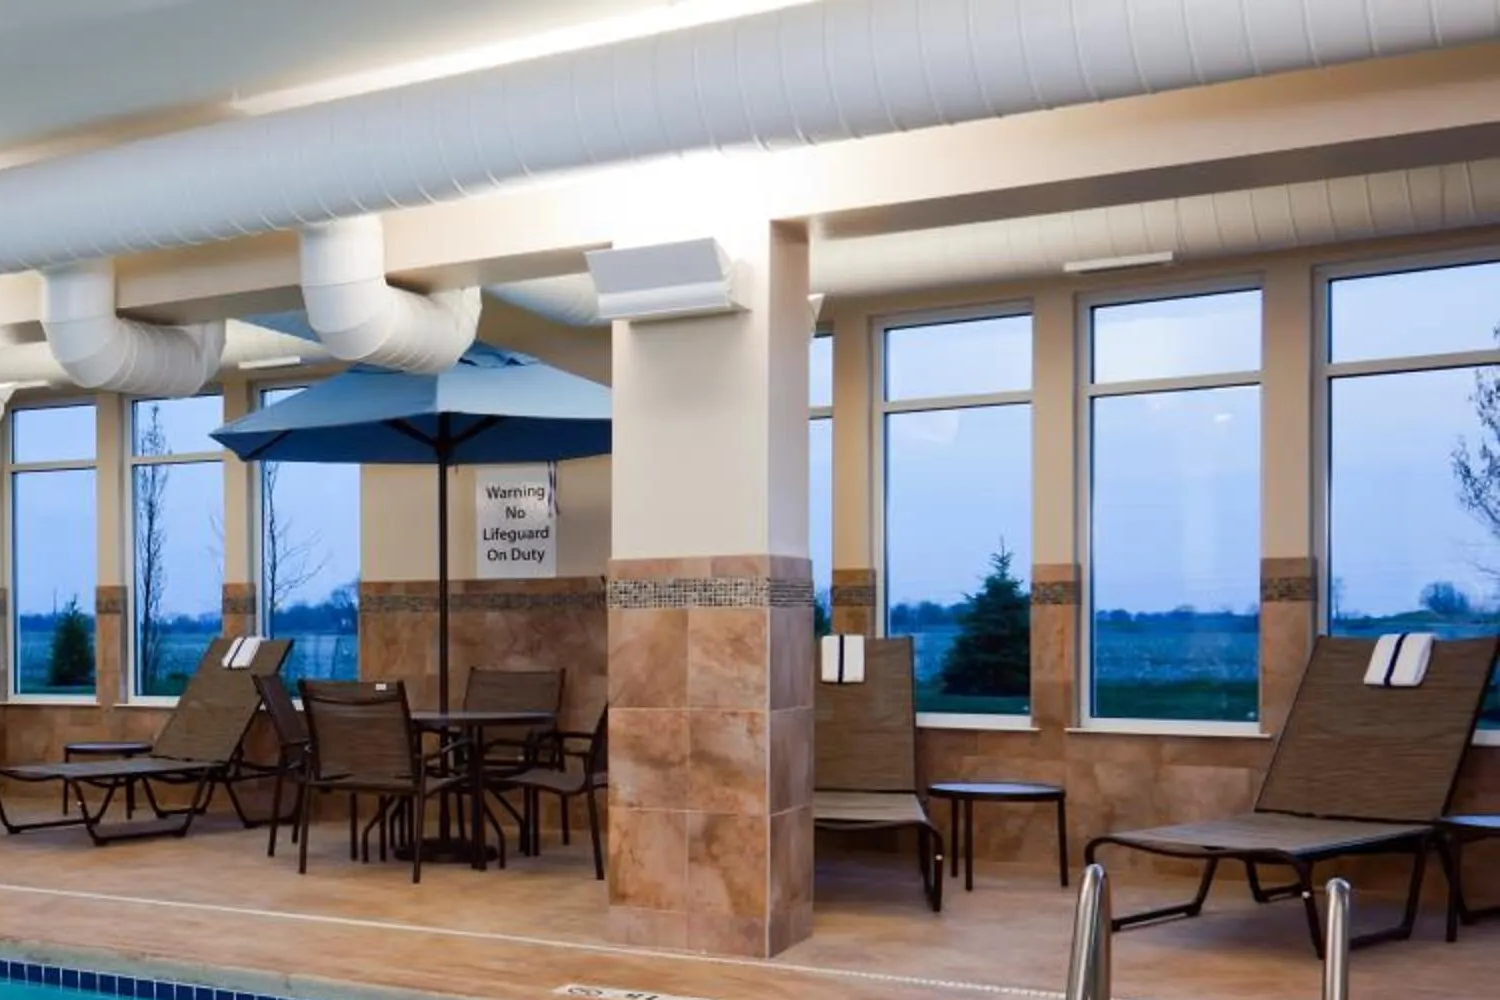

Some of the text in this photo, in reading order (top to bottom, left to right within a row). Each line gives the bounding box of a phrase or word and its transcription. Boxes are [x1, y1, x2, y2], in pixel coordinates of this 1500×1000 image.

[486, 485, 545, 500] Warning
[505, 506, 526, 519] No
[483, 526, 549, 543] Lifeguard
[487, 548, 545, 563] On Duty
